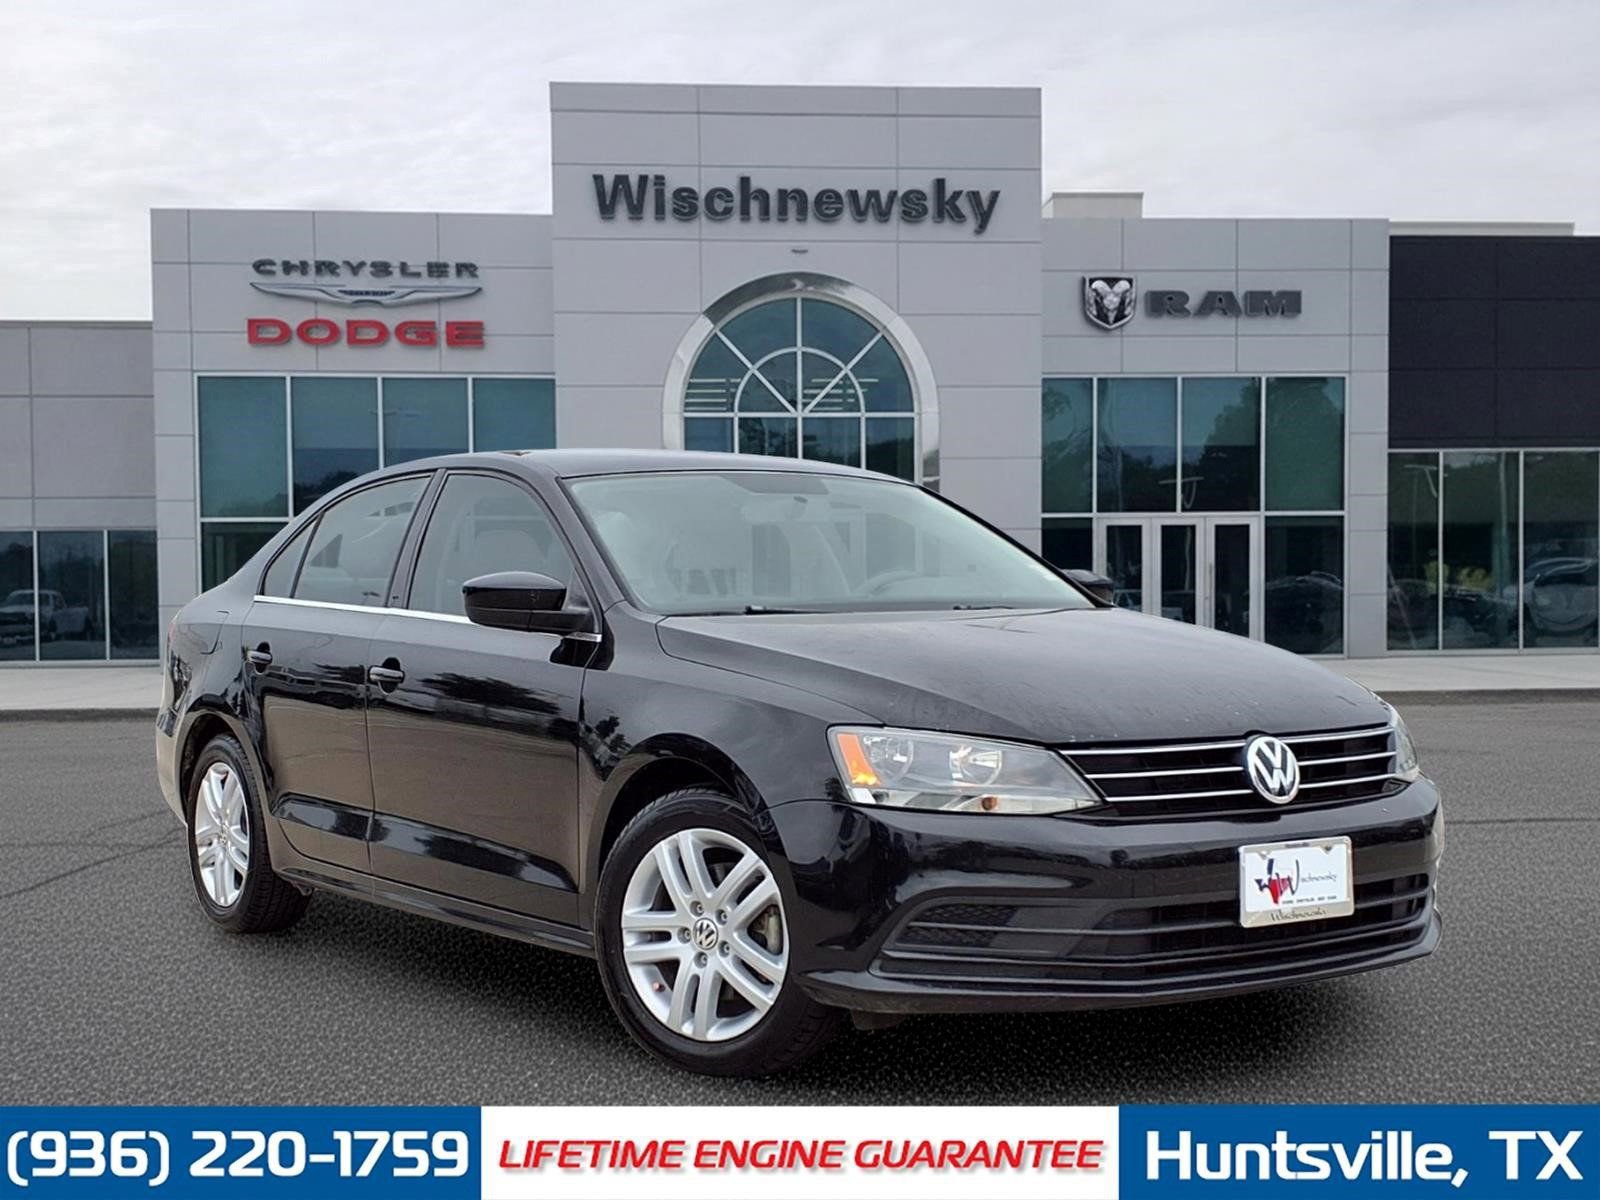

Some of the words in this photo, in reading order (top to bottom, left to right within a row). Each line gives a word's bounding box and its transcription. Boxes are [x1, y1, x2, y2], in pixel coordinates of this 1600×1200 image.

[593, 173, 1000, 235] Wischnewsky
[252, 259, 479, 278] CHRYSLER
[1144, 290, 1302, 318] RAM
[247, 318, 485, 348] DODGE
